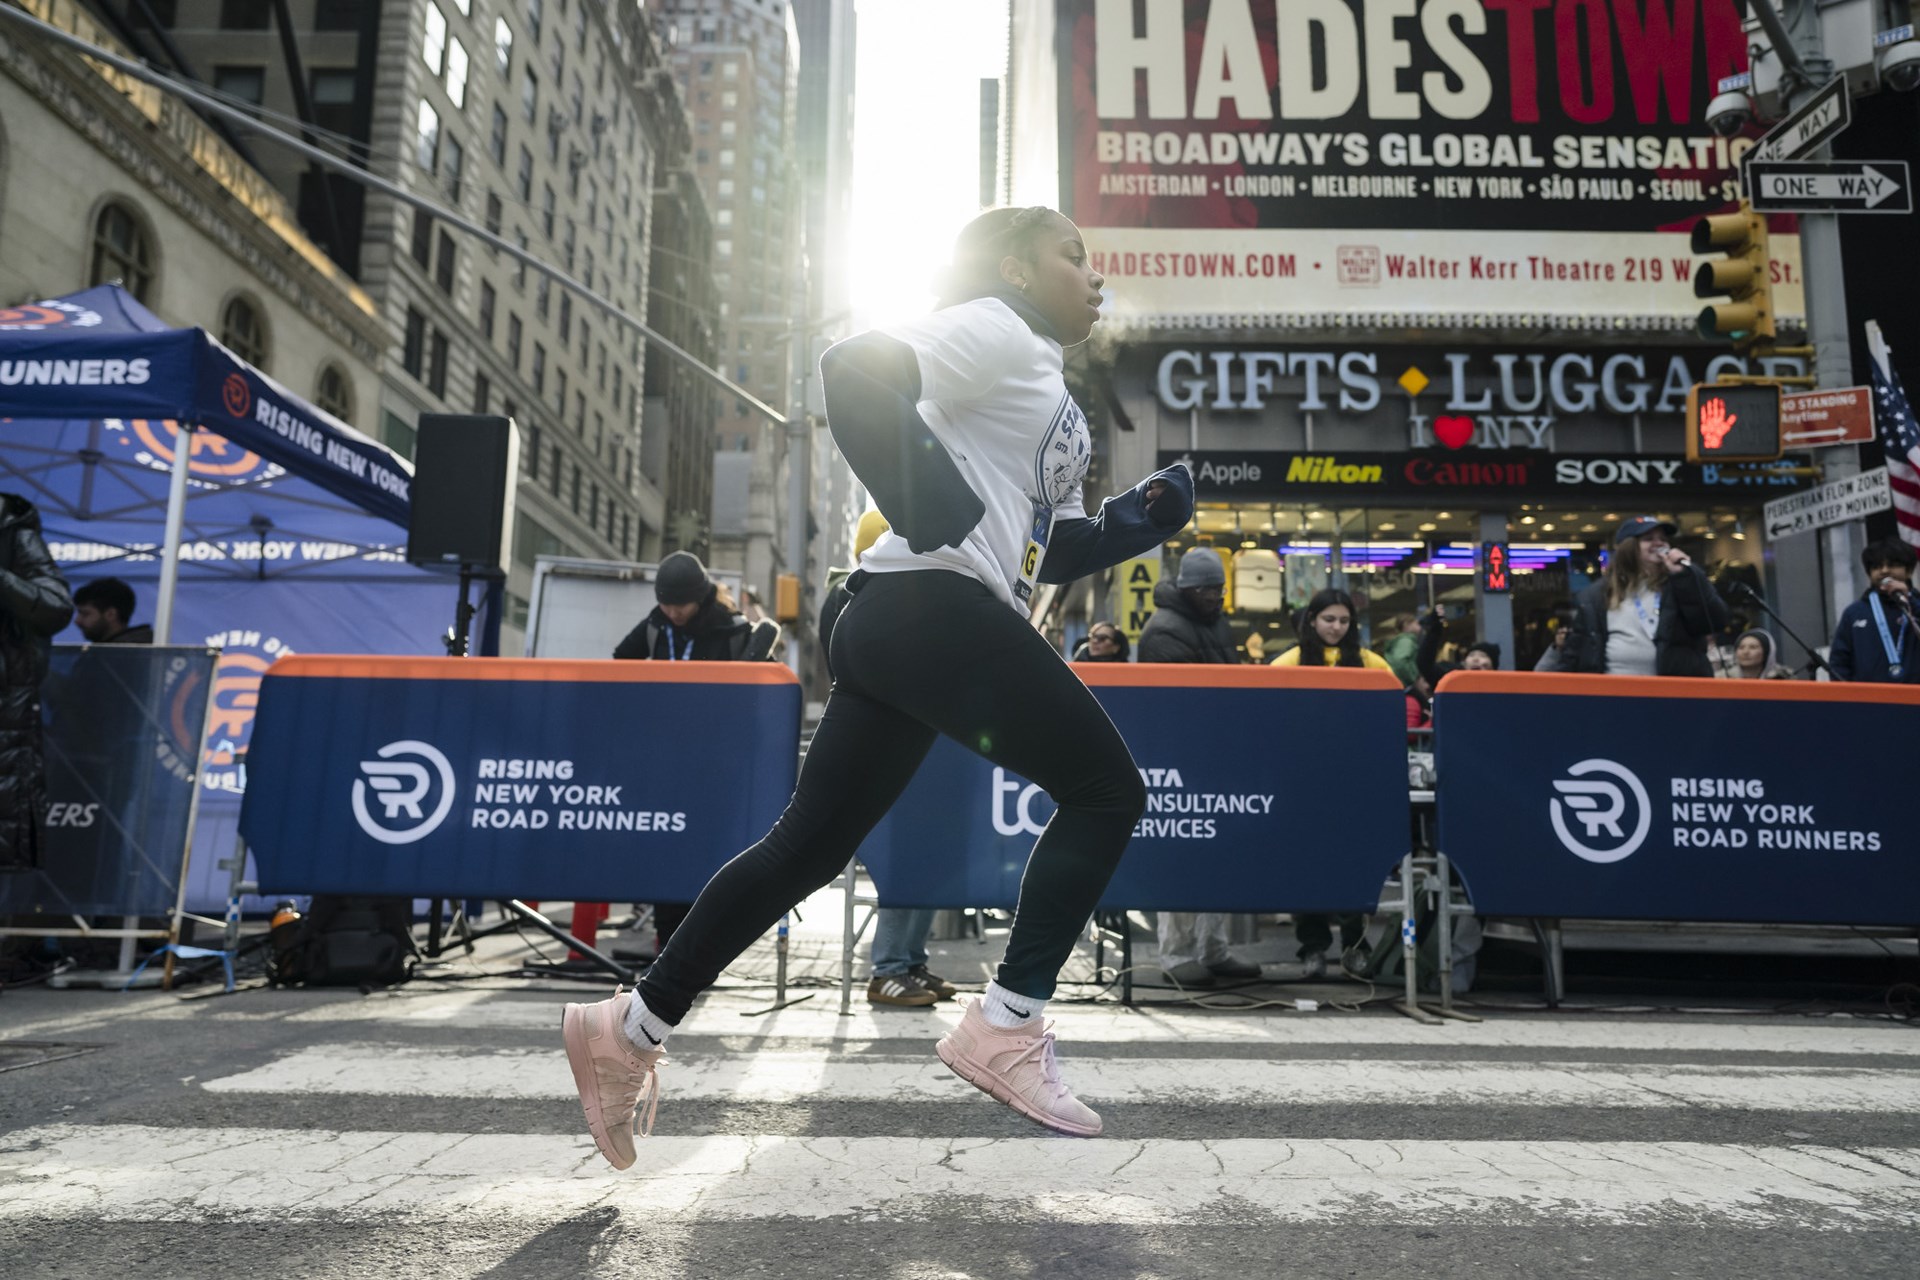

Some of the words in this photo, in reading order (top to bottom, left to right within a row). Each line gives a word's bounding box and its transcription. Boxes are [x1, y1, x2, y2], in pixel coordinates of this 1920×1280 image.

[1799, 102, 1831, 141] WAY
[1097, 131, 1369, 166] BROADWAY'S
[1379, 133, 1544, 168] GLOBAL
[1099, 174, 1207, 196] AMSTERDAM
[1224, 175, 1295, 197] LONDON
[1312, 176, 1418, 198] MELBOURNE
[1434, 177, 1475, 199] NEW
[1477, 177, 1524, 199] YORK
[1540, 173, 1575, 200] SÃO
[1578, 178, 1633, 200] PAULO
[1650, 179, 1706, 201] SEOUL
[1773, 177, 1818, 197] ONE
[1838, 177, 1882, 198] WAY
[1091, 252, 1296, 278] HADESTOWN.COM
[1386, 254, 1459, 280] Walter
[1470, 256, 1518, 281] Kerr
[1528, 256, 1615, 281] Theatre
[1625, 258, 1663, 282] 219
[1672, 258, 1690, 281] W
[0, 358, 151, 386] UNNERS
[1157, 350, 1381, 411] GIFTS
[1798, 393, 1857, 411] STANDING
[1409, 416, 1429, 448] I
[1476, 416, 1554, 449] NY
[255, 397, 324, 456] RISING
[326, 438, 368, 478] NEW
[369, 461, 410, 502] YORK
[1200, 461, 1262, 485] Apple
[1285, 456, 1382, 484] Nikon
[1404, 457, 1527, 486] Canon
[1555, 459, 1682, 484] SONY
[1767, 490, 1823, 519] PEDESTRIAN
[1825, 482, 1853, 501] FLOW
[1857, 471, 1885, 492] ZONE
[1818, 504, 1843, 521] KEEP
[1846, 491, 1888, 514] MOVING
[1489, 545, 1505, 589] ATM
[1129, 563, 1152, 630] ATM
[477, 759, 574, 780] RISING
[1138, 768, 1184, 788] ATA
[475, 783, 540, 804] NEW
[549, 785, 622, 805] YORK
[1671, 777, 1764, 799] RISING
[45, 803, 99, 828] ERS
[1147, 793, 1274, 814] NSULTANCY
[1672, 803, 1733, 823] NEW
[1743, 804, 1815, 825] YORK
[471, 808, 549, 830] ROAD
[558, 810, 687, 832] RUNNERS
[1131, 818, 1217, 839] ERVICES
[1673, 827, 1748, 848] ROAD
[1758, 830, 1882, 851] RUNNERS
